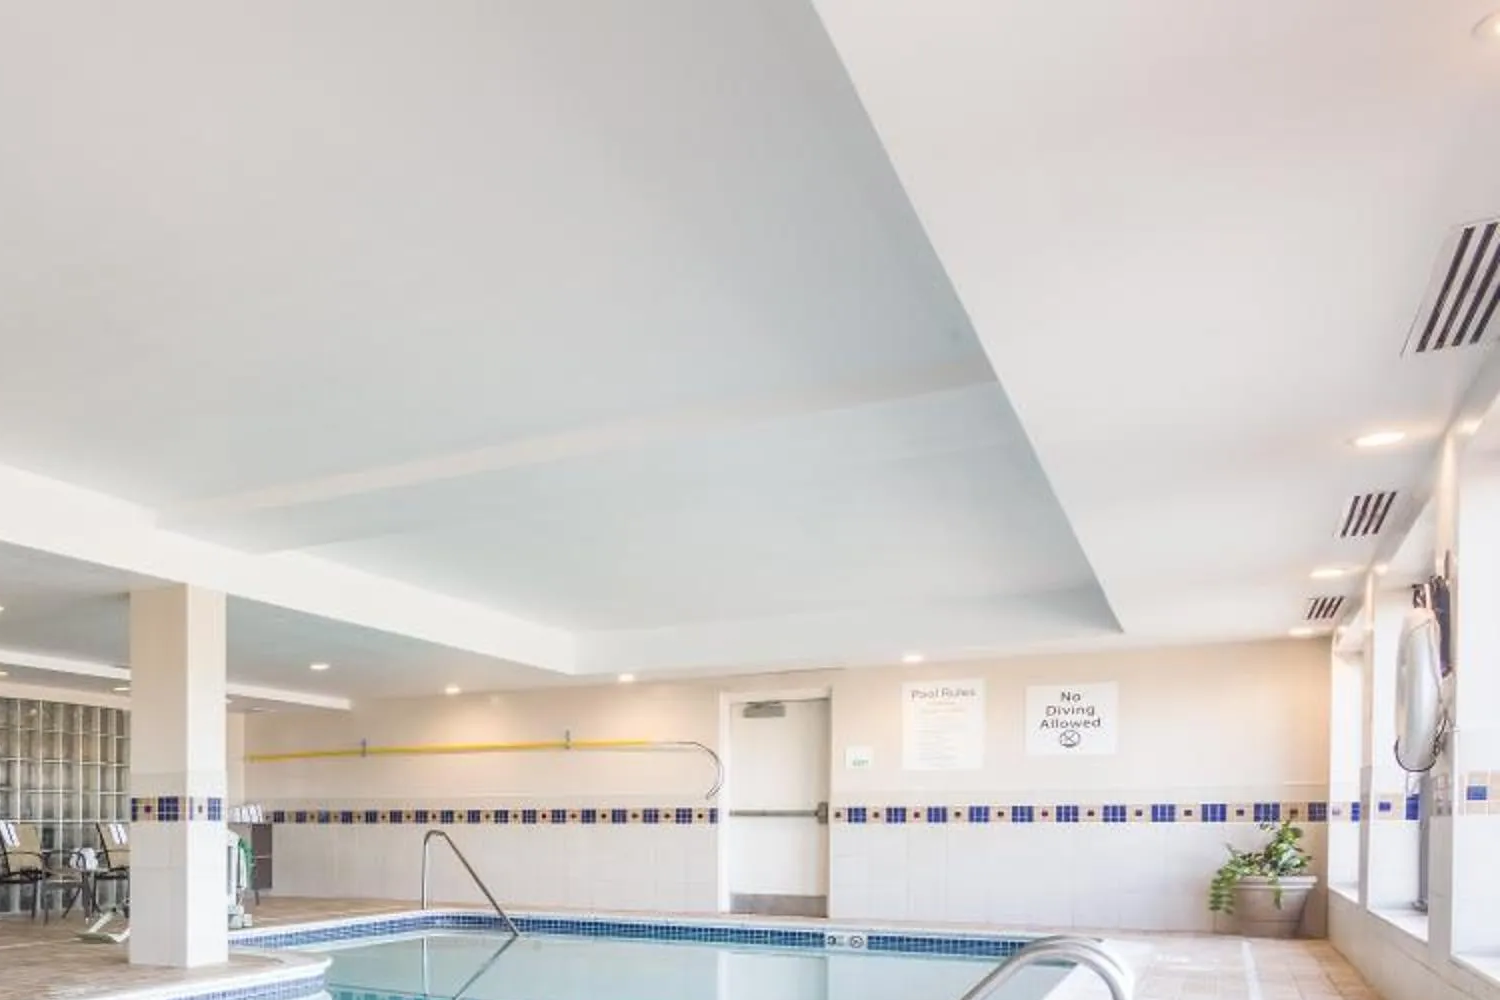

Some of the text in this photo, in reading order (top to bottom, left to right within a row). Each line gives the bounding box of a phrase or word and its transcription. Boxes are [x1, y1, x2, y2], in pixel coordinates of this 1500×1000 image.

[910, 687, 976, 701] Pool Rules
[1060, 691, 1081, 702] No
[1045, 705, 1095, 717] Diving
[1040, 717, 1101, 729] Allowed
